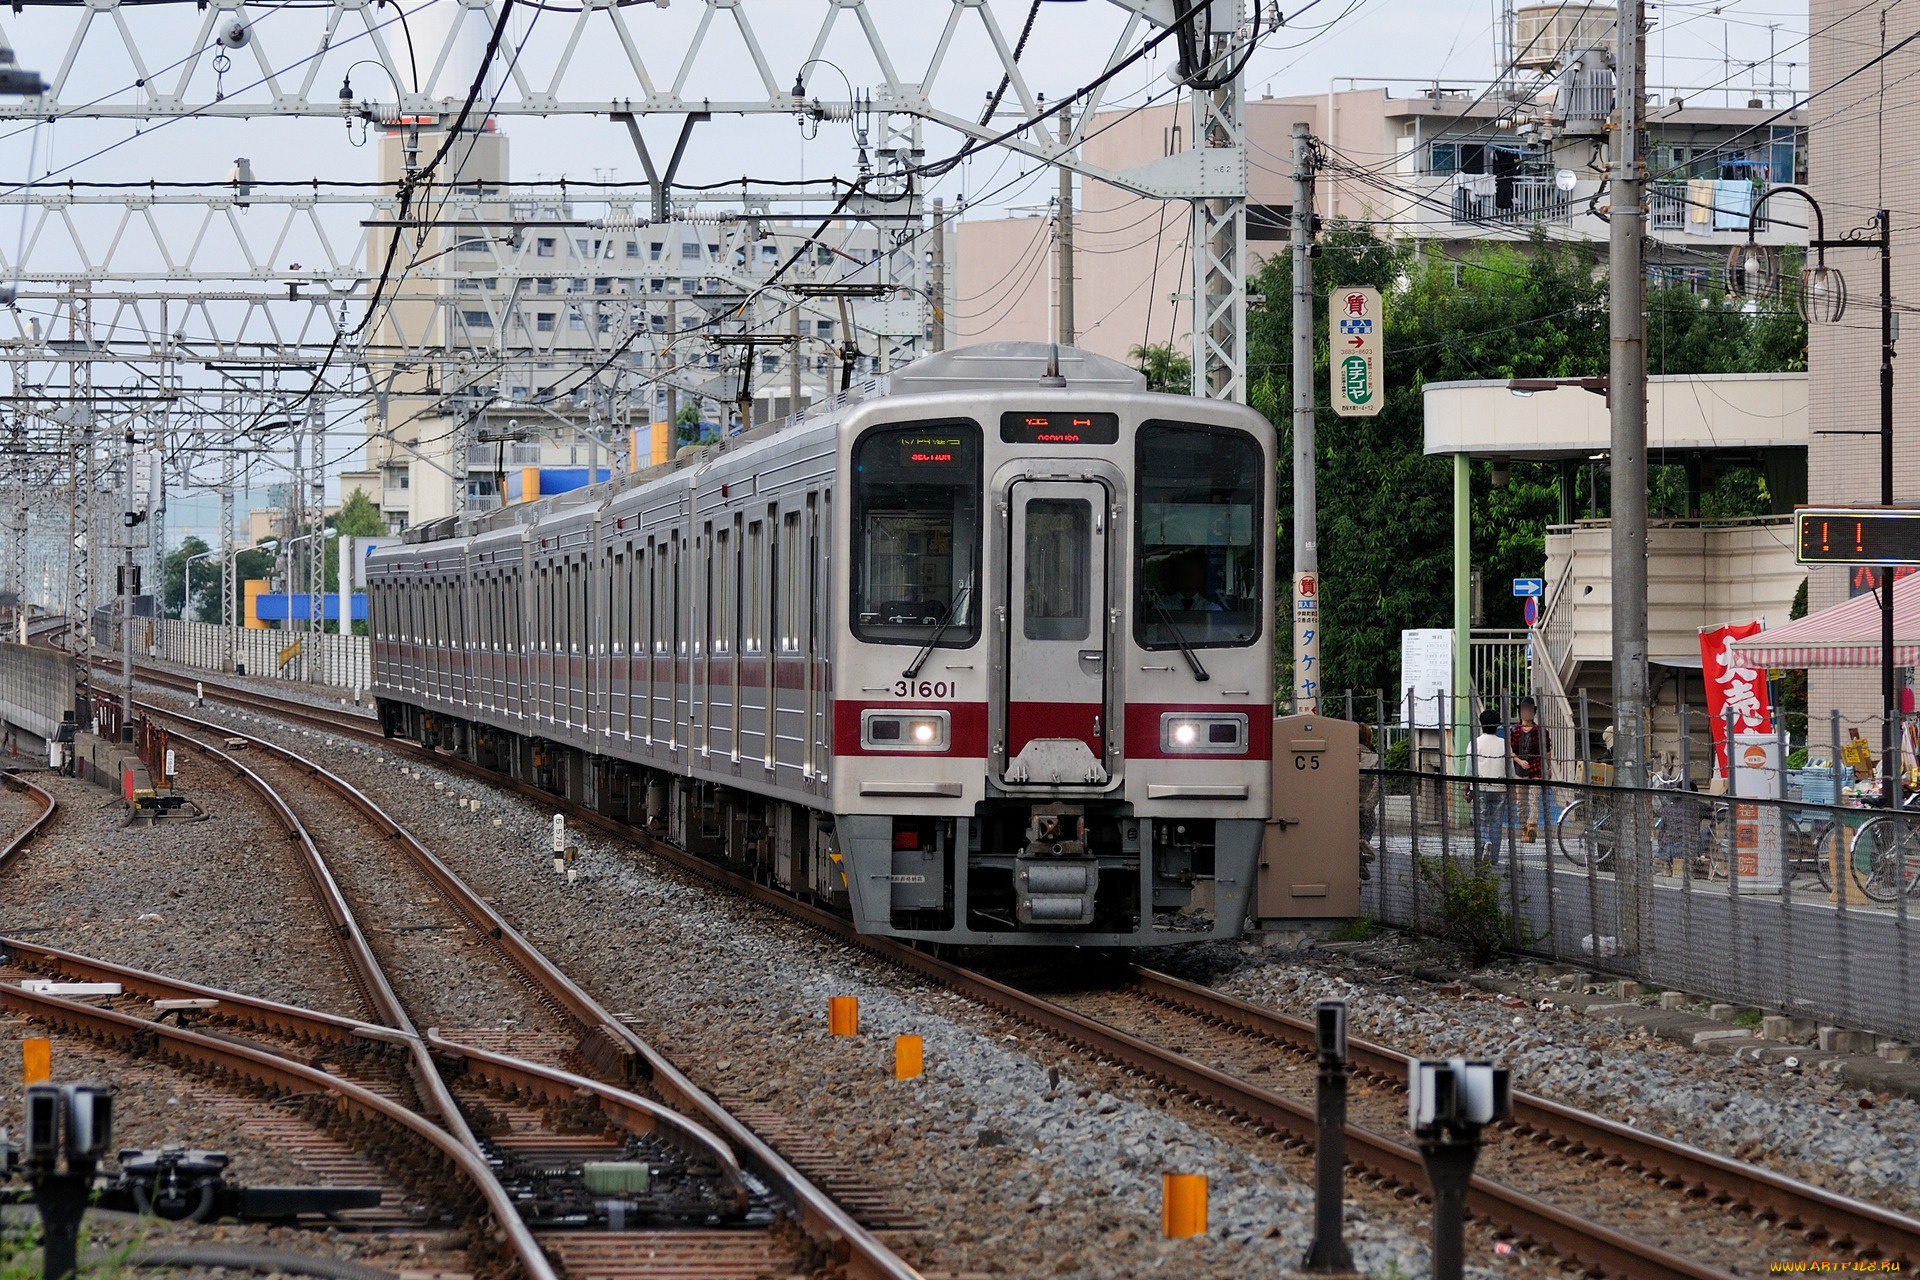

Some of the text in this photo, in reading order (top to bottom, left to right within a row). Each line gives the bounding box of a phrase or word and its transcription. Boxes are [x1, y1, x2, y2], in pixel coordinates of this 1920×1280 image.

[1347, 294, 1365, 316] 質
[1348, 360, 1366, 400] エチゴヤ
[1300, 578, 1315, 595] 質
[1301, 629, 1317, 697] タケヤ
[894, 681, 956, 699] 31601
[1714, 635, 1764, 760] 大売
